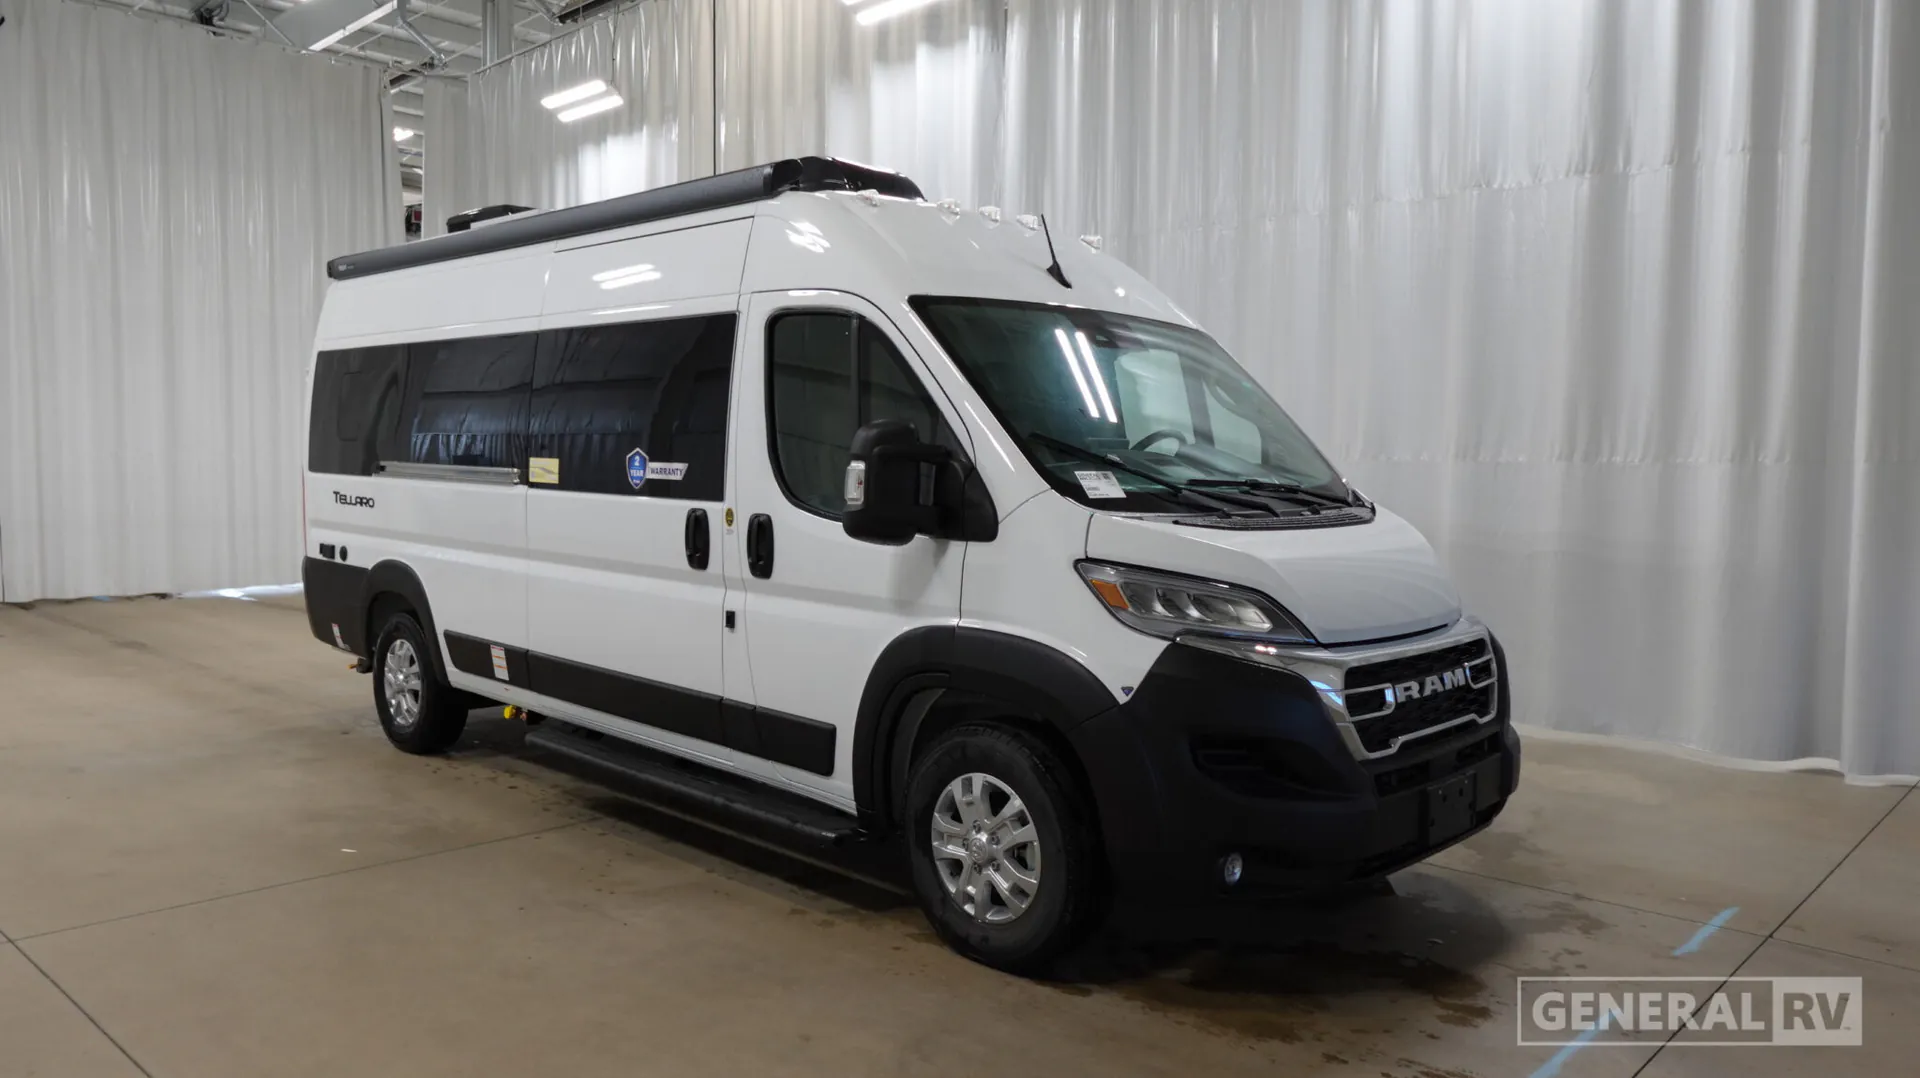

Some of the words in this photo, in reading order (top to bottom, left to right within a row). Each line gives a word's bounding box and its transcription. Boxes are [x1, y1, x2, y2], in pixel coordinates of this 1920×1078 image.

[634, 455, 641, 467] 2
[630, 469, 644, 477] YEAR
[650, 467, 684, 477] WARRANTY
[333, 491, 375, 508] TELLARO
[1395, 668, 1466, 703] RAM
